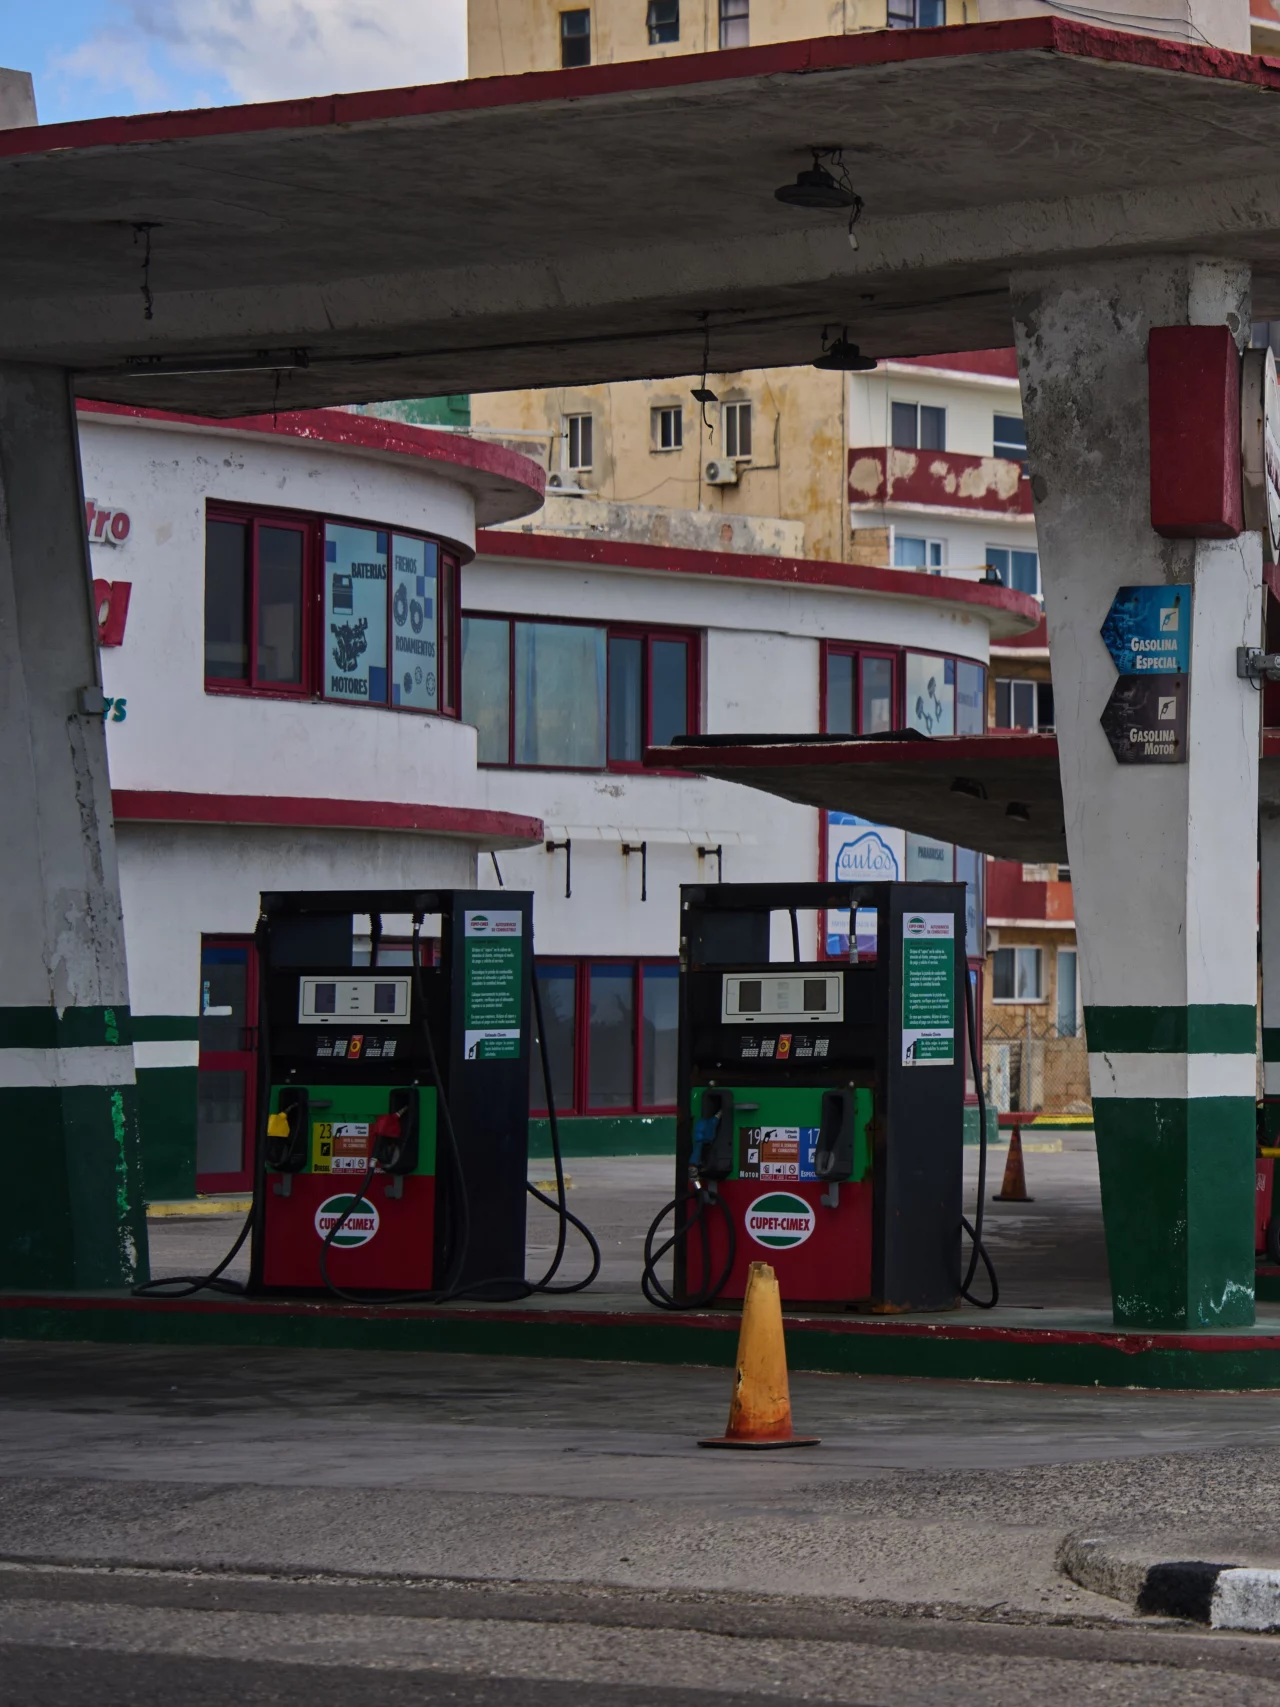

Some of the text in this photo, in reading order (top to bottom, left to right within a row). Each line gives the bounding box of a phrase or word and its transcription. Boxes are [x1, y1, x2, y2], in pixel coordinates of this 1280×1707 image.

[351, 562, 387, 580] BATERIAS
[395, 555, 417, 574] FRENOS
[395, 635, 436, 658] RODAMIENTOS
[1130, 637, 1178, 652] GASOLINA
[1136, 655, 1177, 669] ESPECIAL
[331, 676, 368, 695] MOTORES
[1129, 728, 1176, 743] GASOLINA
[1144, 742, 1175, 755] MOTOR
[841, 843, 894, 870] autos
[917, 846, 945, 861] PARABRISAS
[319, 1123, 332, 1139] 23
[748, 1128, 761, 1145] 19
[807, 1128, 821, 1145] 17
[739, 1170, 759, 1178] MOTOR
[319, 1217, 375, 1231] CUP-CIMEX
[750, 1216, 810, 1231] CUPET-CIMEX
